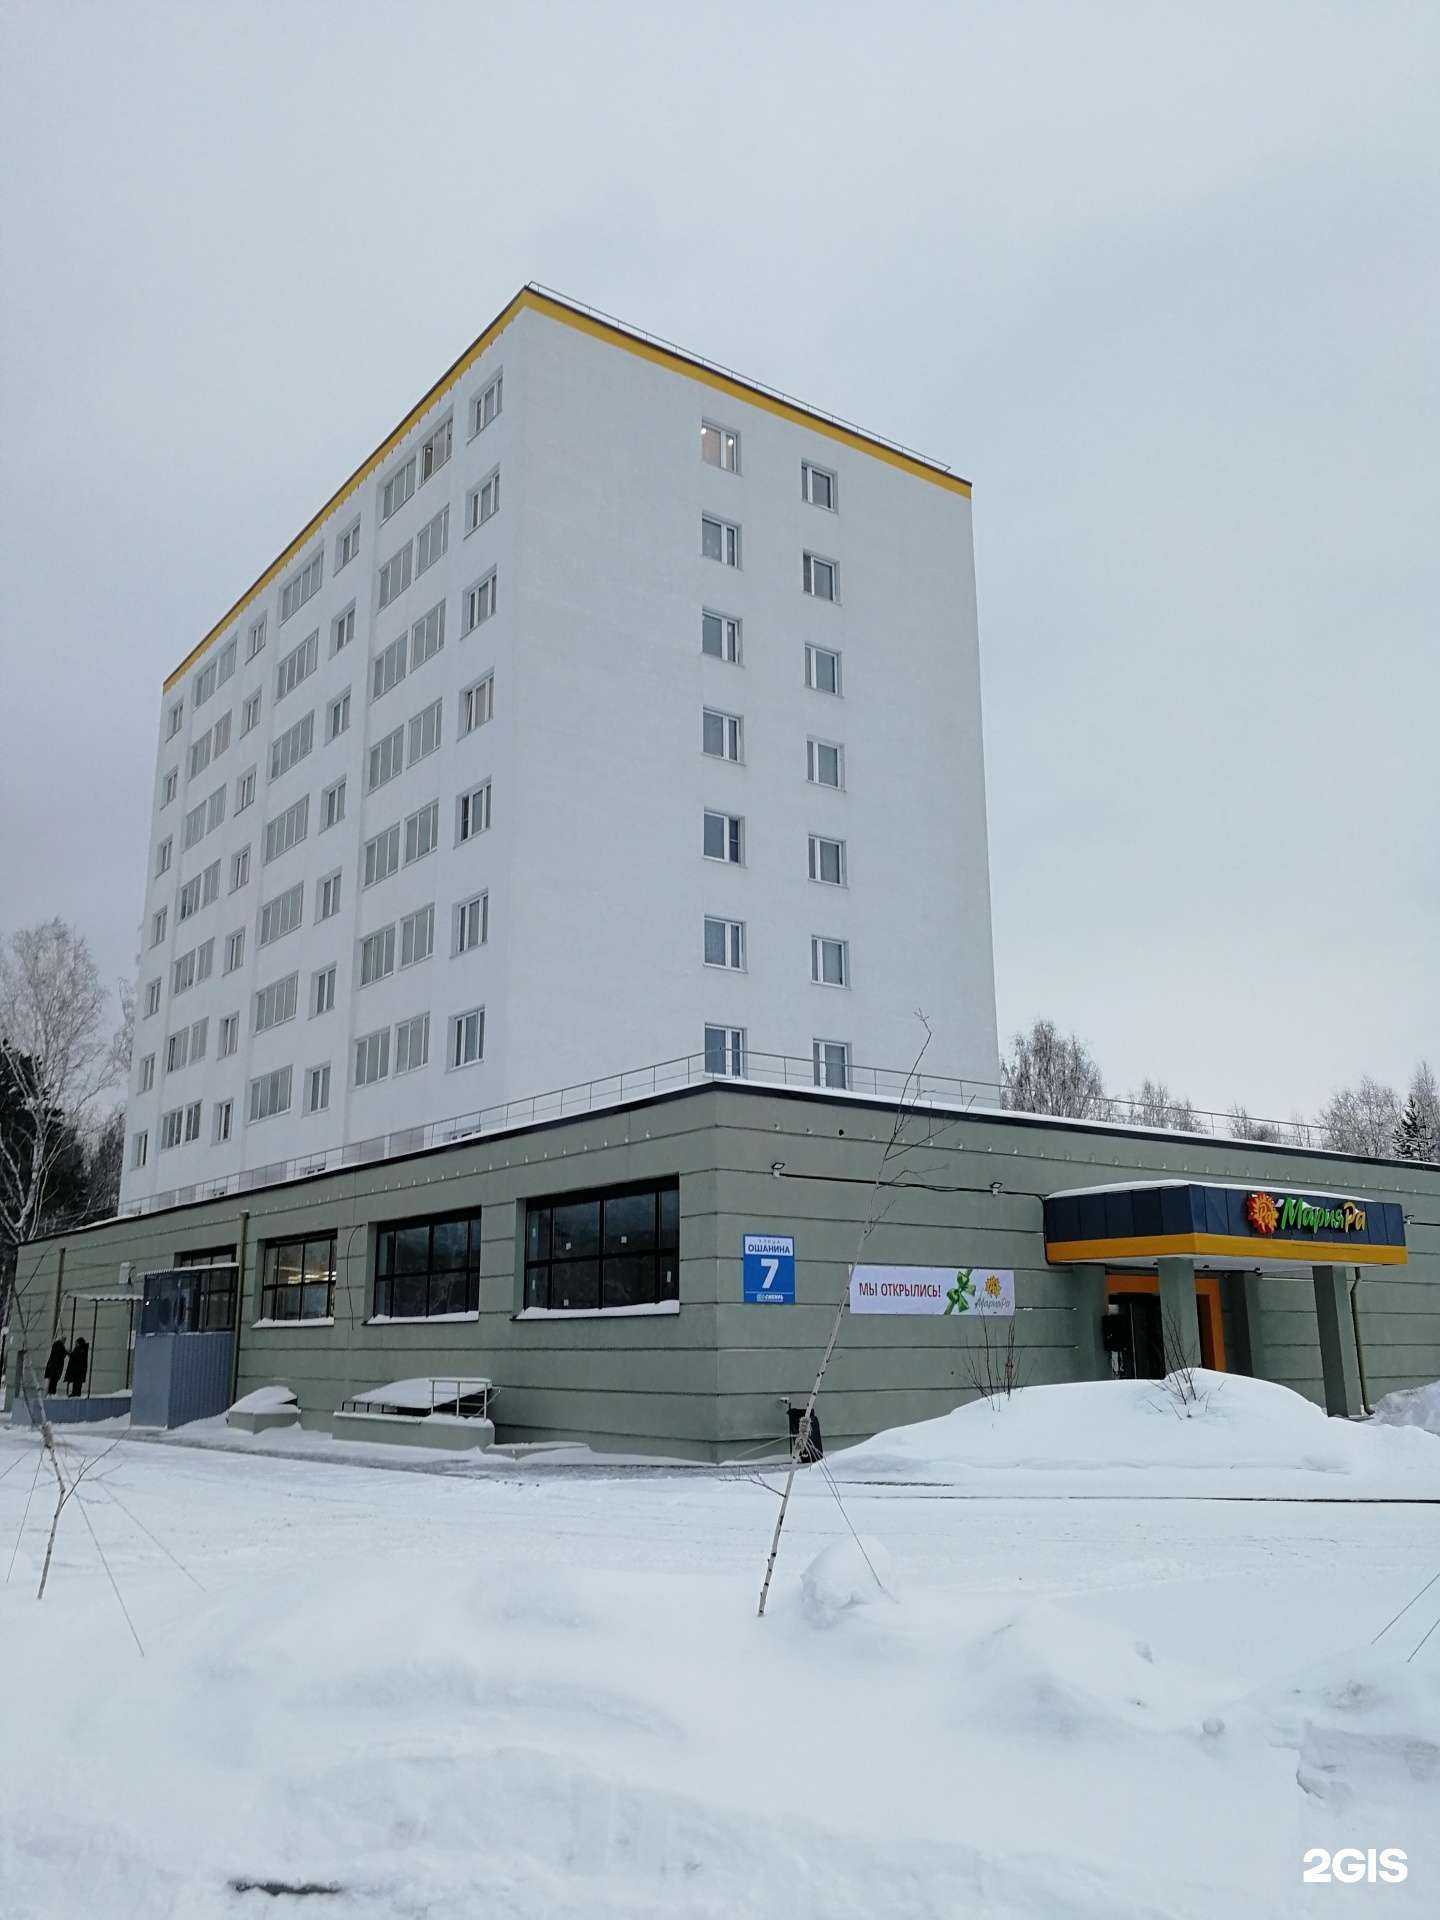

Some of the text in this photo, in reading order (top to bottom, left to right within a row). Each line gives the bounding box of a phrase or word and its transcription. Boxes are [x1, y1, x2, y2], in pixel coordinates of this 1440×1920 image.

[748, 1244, 790, 1254] ОШАНИНА
[760, 1258, 779, 1289] 7
[858, 1282, 942, 1298] МЫ ОТКРЫЛИСЬ!
